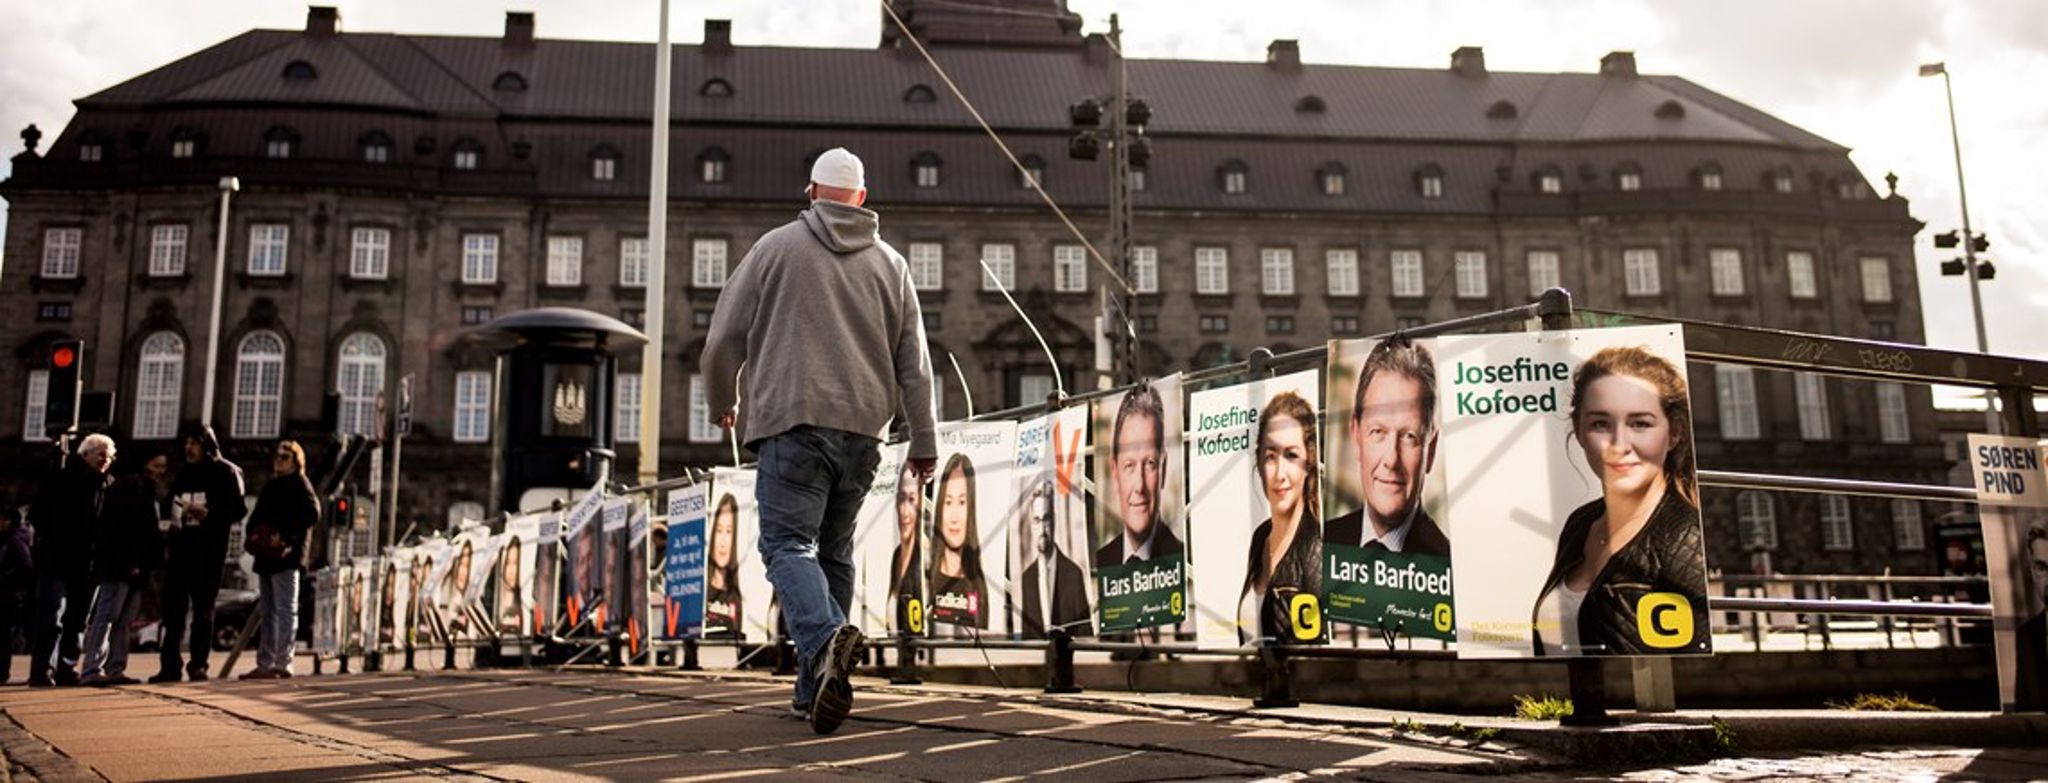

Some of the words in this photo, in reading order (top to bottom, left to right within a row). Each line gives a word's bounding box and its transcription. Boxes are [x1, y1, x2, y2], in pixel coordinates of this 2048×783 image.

[1454, 357, 1569, 385] Josefine
[1456, 386, 1558, 415] Kofoed
[1197, 406, 1258, 431] Josefine
[1197, 429, 1249, 456] Kofoed
[1053, 419, 1083, 496] V
[1979, 445, 2038, 470] SØREN
[1983, 470, 2025, 495] PIND
[1103, 576, 1131, 597] Lars
[1132, 561, 1181, 593] Barfoed
[1330, 554, 1369, 584] Lars
[1374, 560, 1451, 596] Barfoed
